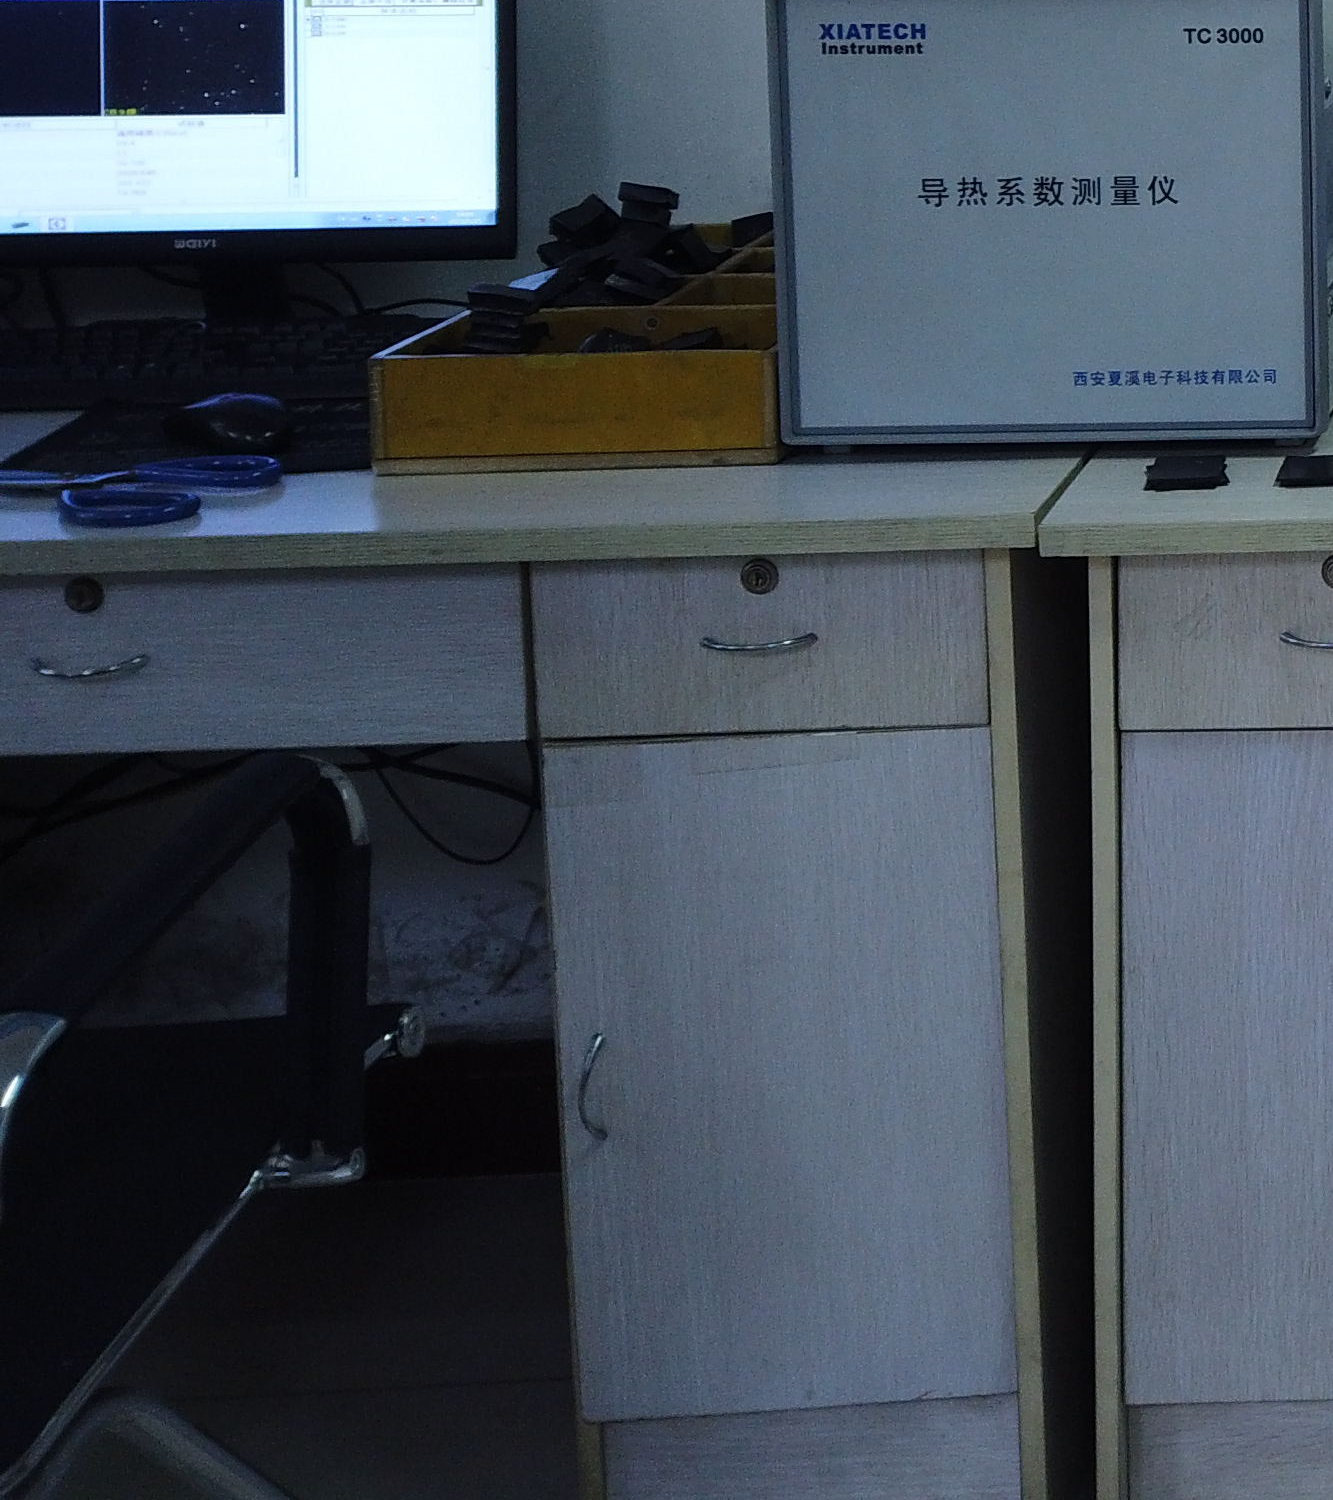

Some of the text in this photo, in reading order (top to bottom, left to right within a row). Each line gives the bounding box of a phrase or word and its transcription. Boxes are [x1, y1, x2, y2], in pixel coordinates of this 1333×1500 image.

[819, 22, 927, 41] XIATECH
[1183, 27, 1265, 45] TC 3000
[821, 41, 924, 56] Instrument
[917, 175, 1180, 208] 导热系数测量仪
[1072, 368, 1279, 388] 西安夏溪电子科技有限公司
